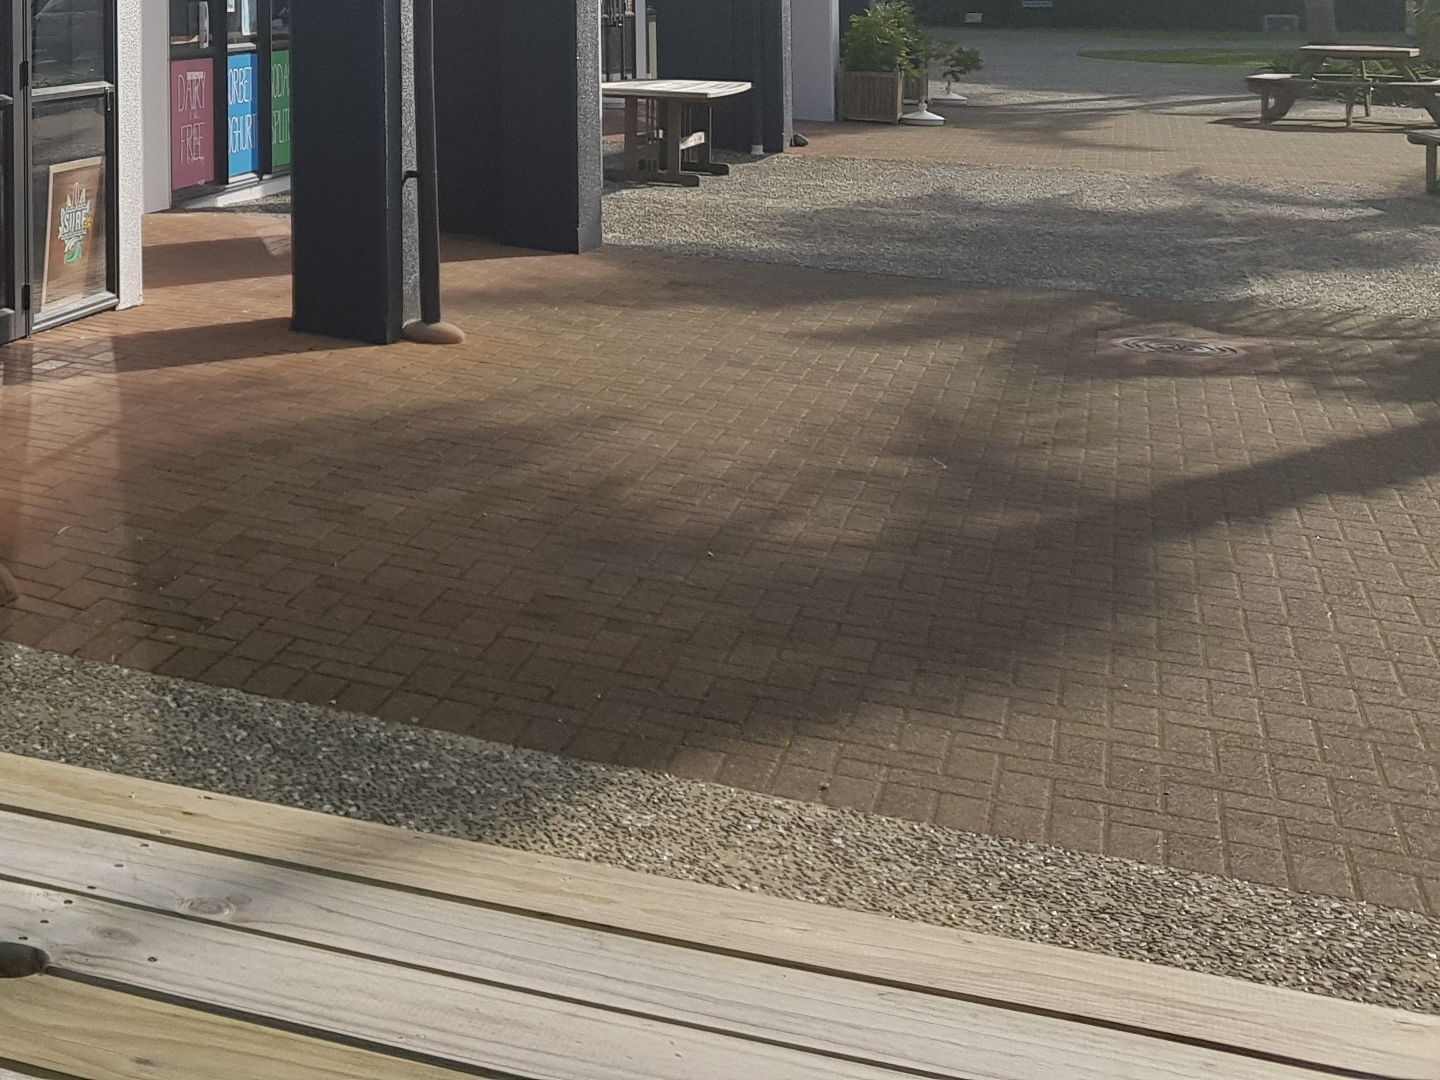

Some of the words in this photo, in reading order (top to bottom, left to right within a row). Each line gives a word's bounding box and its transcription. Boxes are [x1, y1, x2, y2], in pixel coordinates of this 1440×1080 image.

[177, 72, 207, 112] DAIRY
[228, 66, 254, 105] ORBET
[180, 121, 205, 164] FREE
[64, 210, 87, 233] SURF
